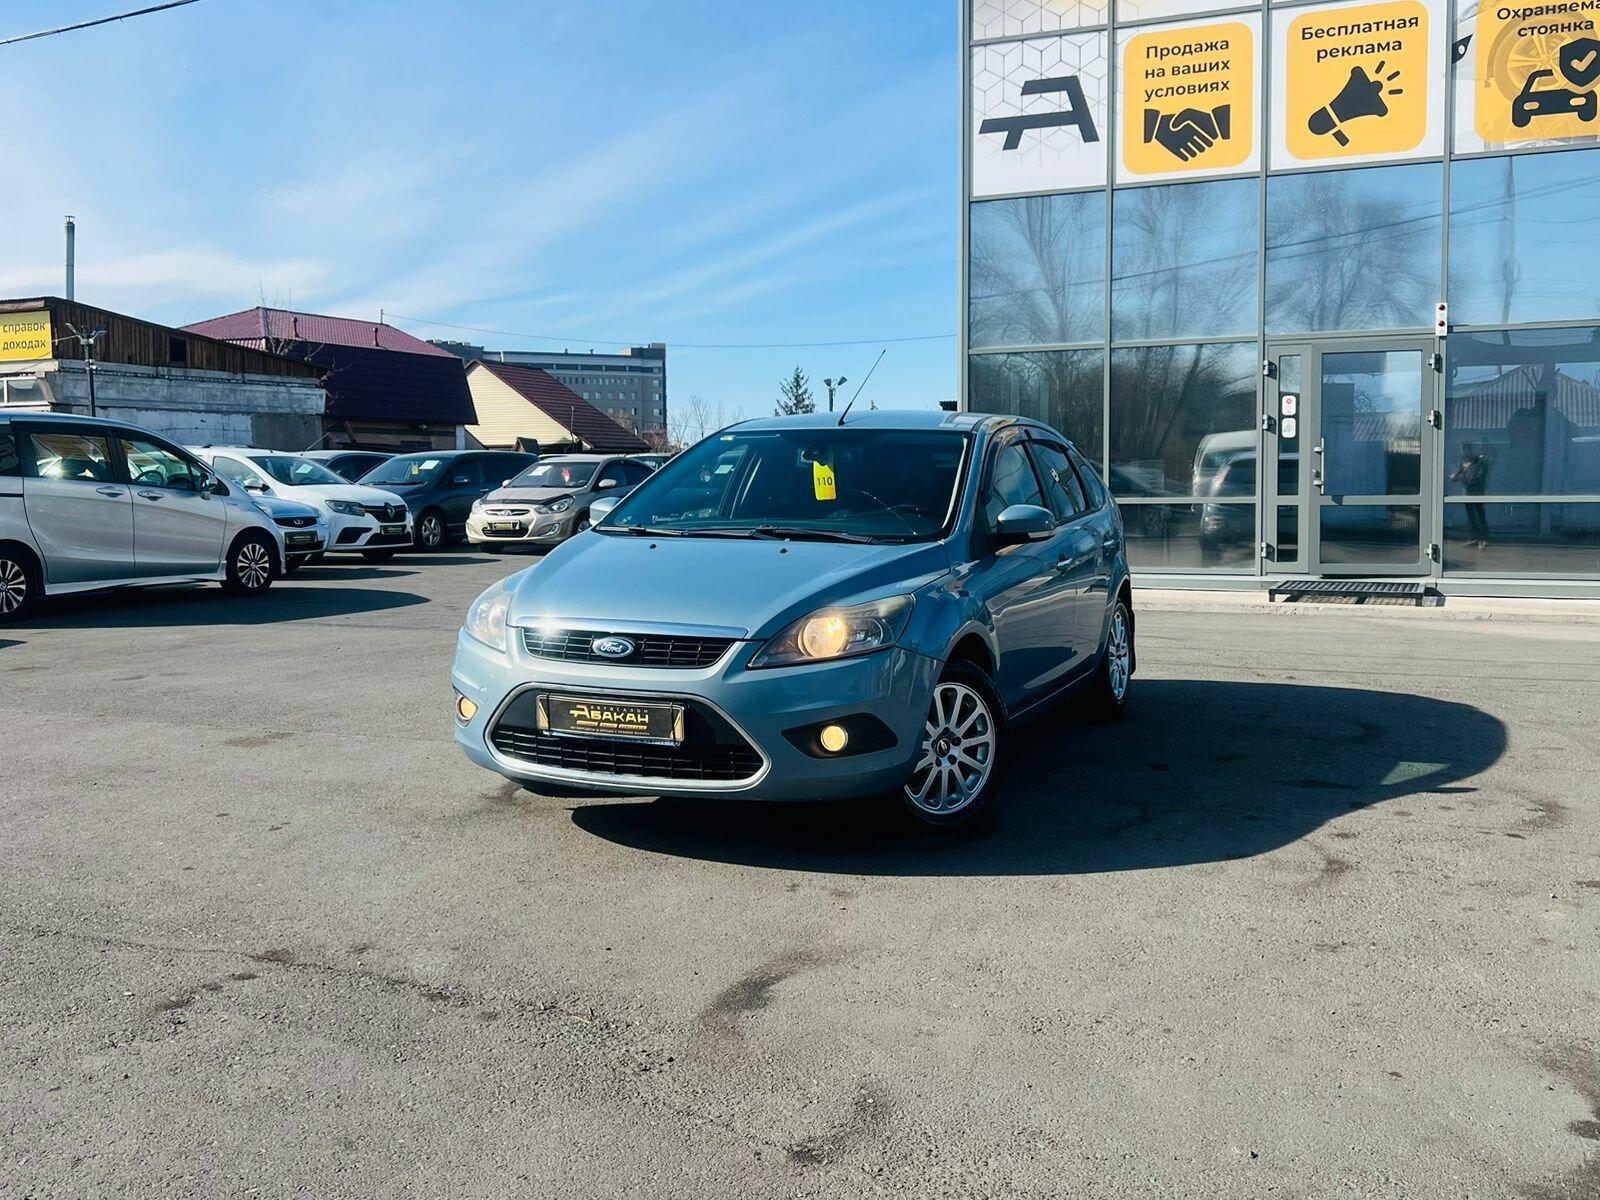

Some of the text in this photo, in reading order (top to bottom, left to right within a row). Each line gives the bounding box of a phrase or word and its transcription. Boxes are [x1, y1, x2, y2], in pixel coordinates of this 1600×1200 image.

[1302, 16, 1419, 40] Бесплатная
[1517, 20, 1594, 37] стоянка
[1146, 39, 1230, 60] Продажа
[1316, 40, 1402, 63] реклама
[1145, 60, 1231, 79] на ваших
[1144, 80, 1230, 102] условиях
[3, 322, 46, 335] справок
[3, 339, 46, 351] доходах
[817, 477, 833, 486] 110
[600, 641, 623, 653] Ford
